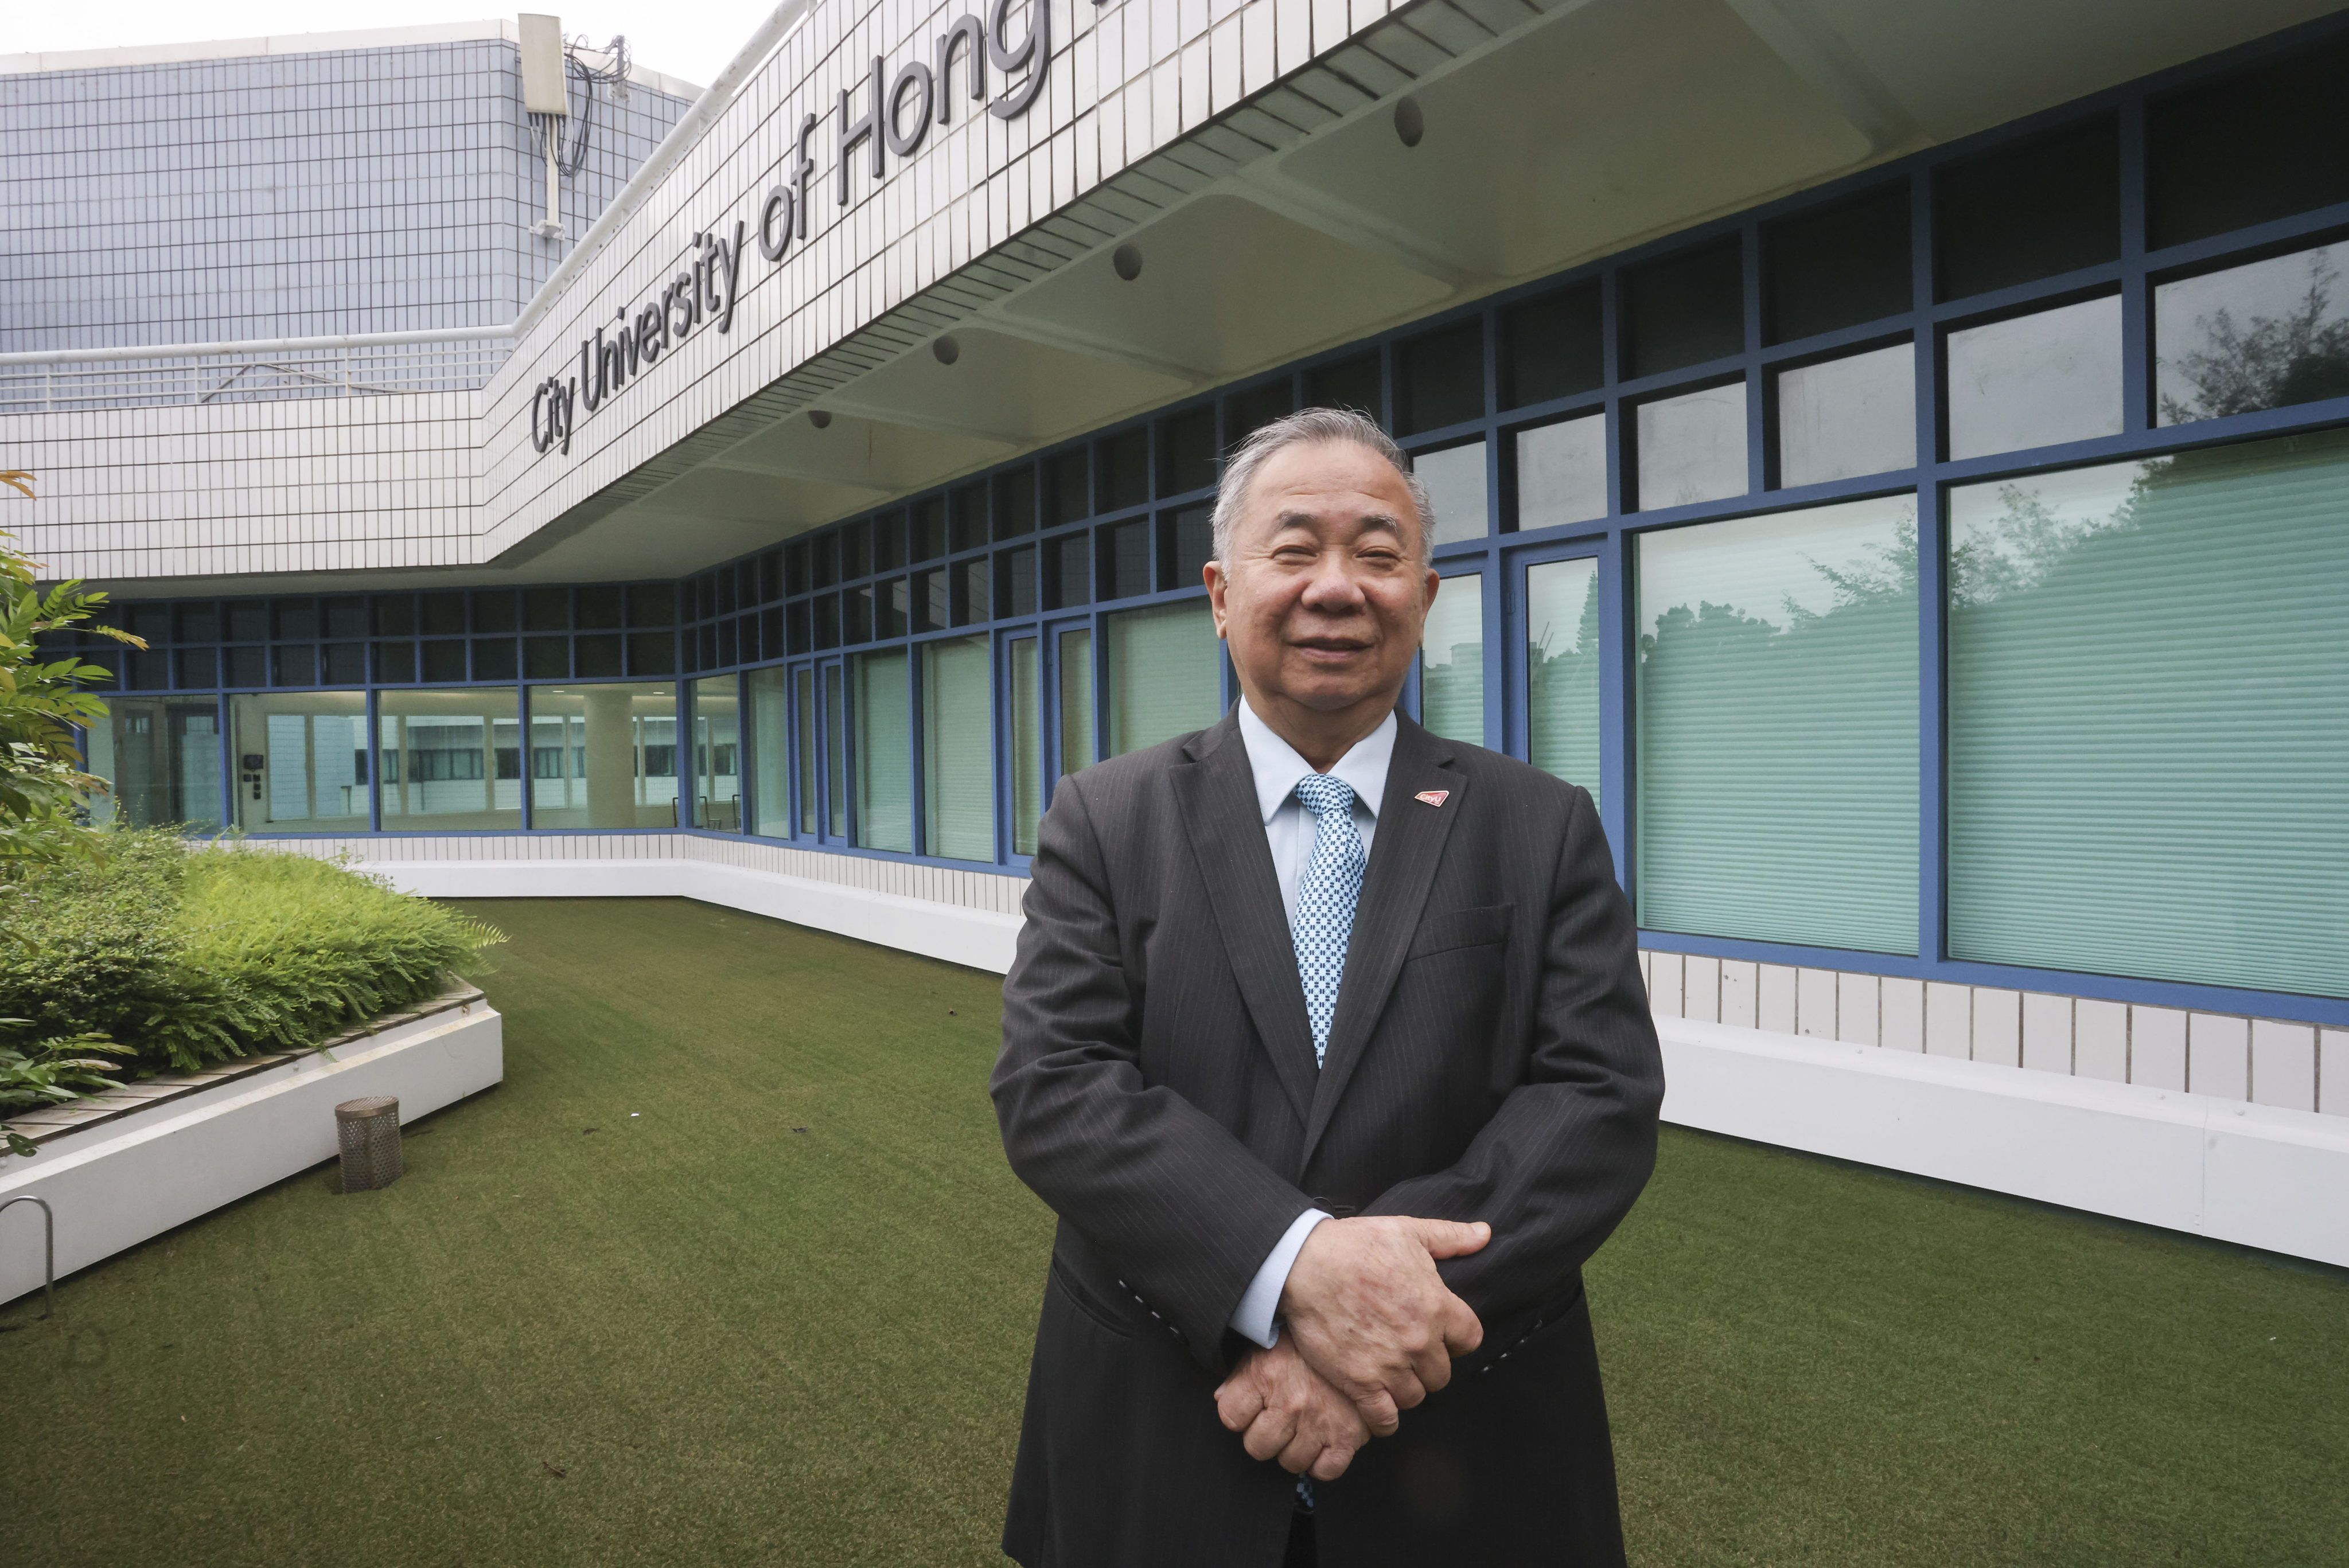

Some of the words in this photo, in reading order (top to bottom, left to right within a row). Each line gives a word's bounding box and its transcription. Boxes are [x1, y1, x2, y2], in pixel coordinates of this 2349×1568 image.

[532, 376, 575, 455] City
[581, 220, 745, 411] University
[759, 113, 815, 262] of
[836, 0, 1051, 206] Hong
[1420, 794, 1442, 802] CityU
